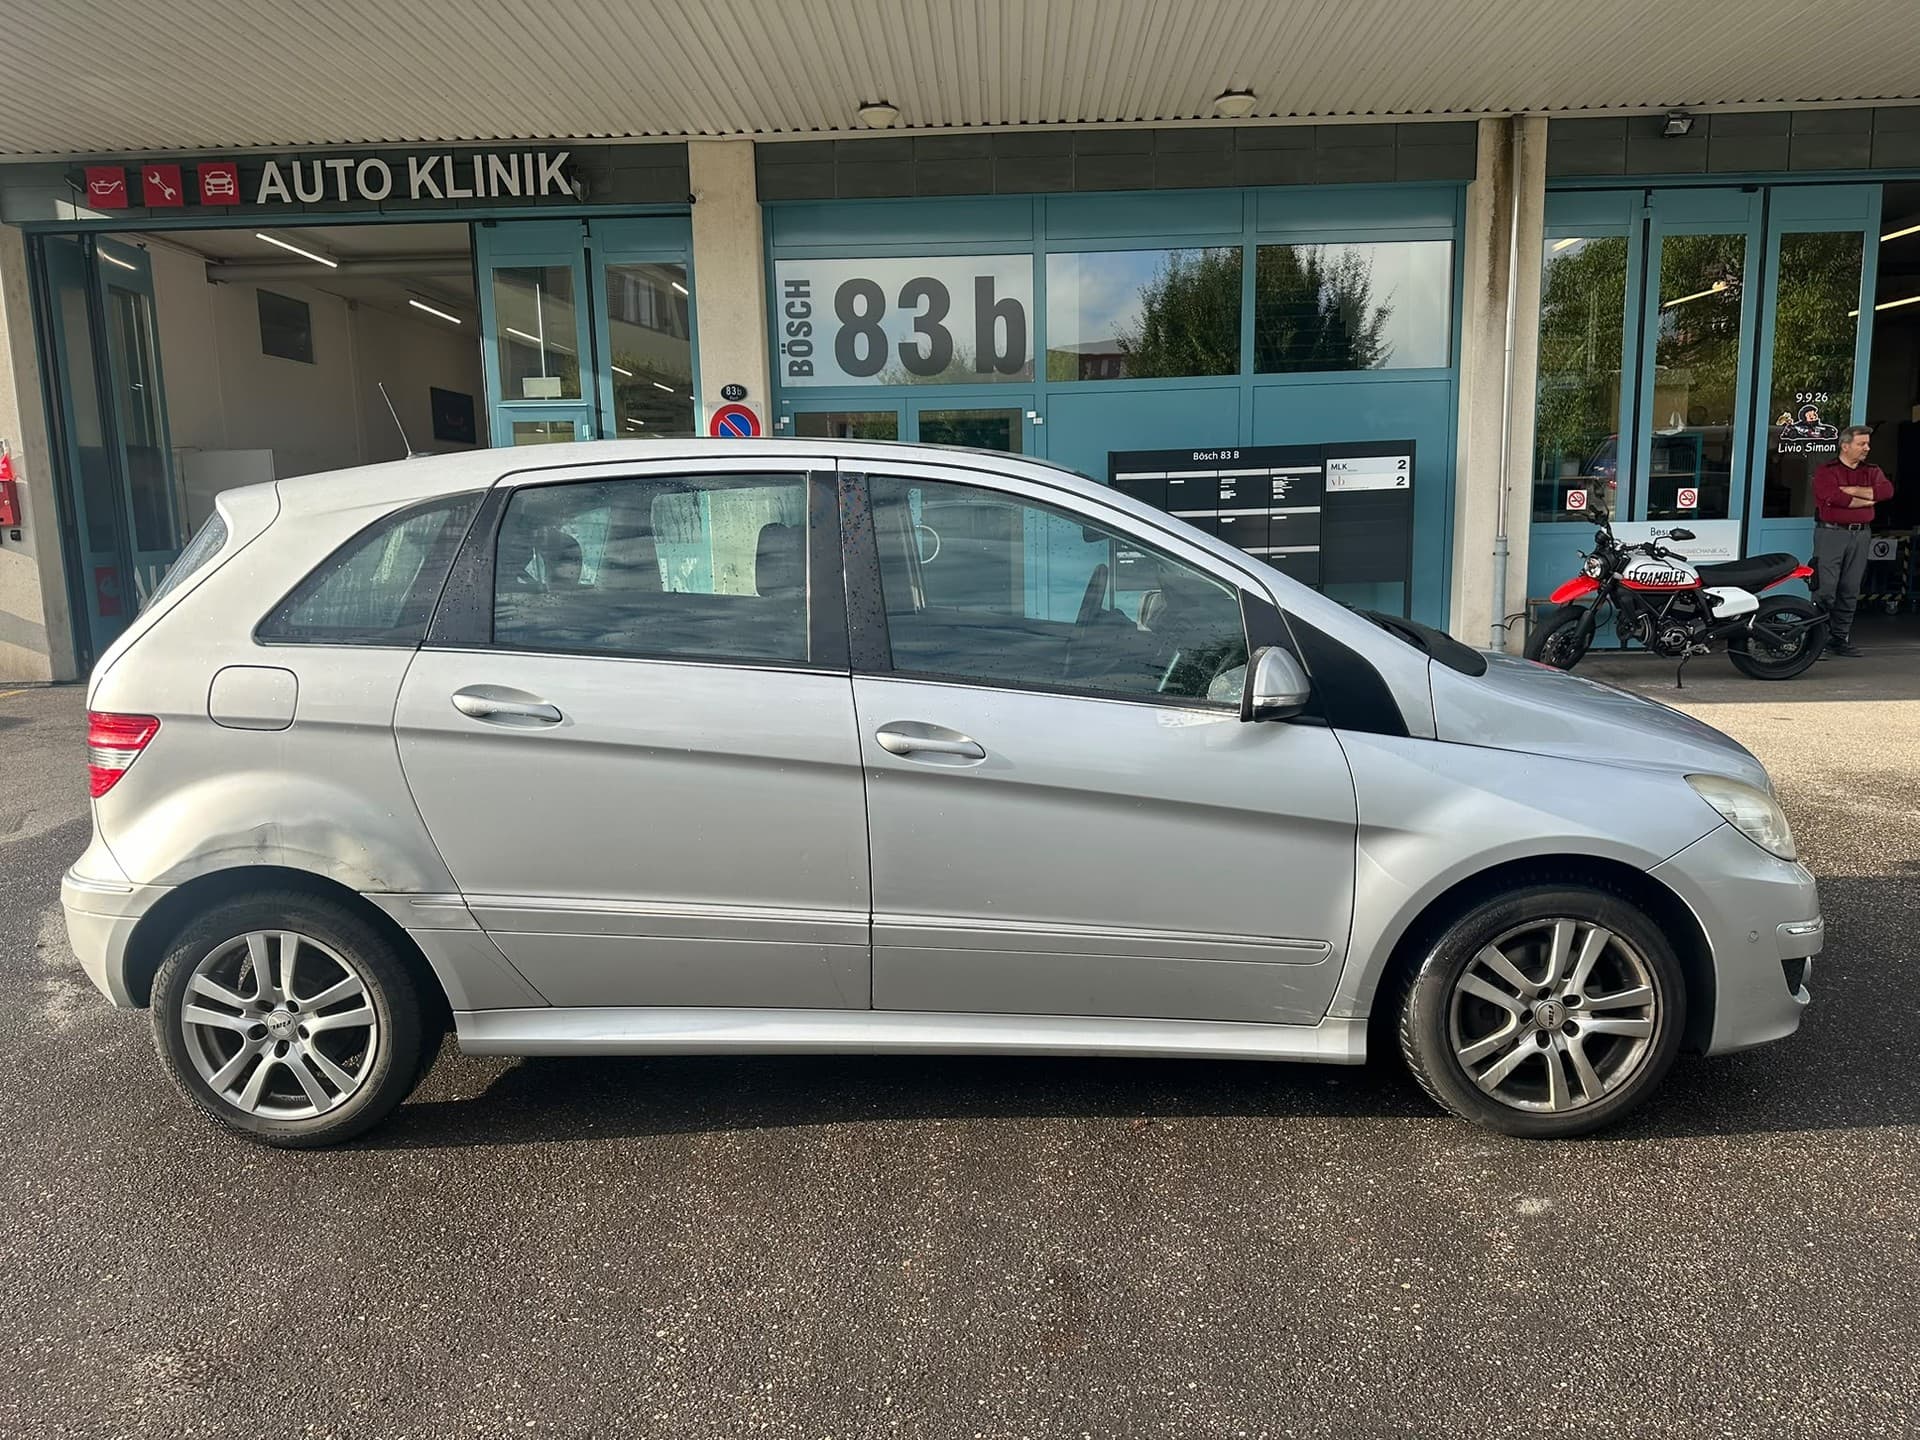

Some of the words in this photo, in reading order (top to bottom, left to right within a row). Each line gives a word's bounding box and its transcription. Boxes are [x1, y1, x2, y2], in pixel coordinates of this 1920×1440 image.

[256, 158, 392, 204] AUTO
[407, 151, 574, 200] KLINIK
[781, 279, 814, 377] BÖSCH
[1795, 392, 1829, 403] 9.9.26
[1778, 442, 1802, 453] Livio
[1805, 442, 1836, 452] Simon
[1220, 450, 1232, 460] 83
[1233, 450, 1240, 459] B
[1330, 463, 1348, 471] MLK
[1397, 459, 1407, 470] 2
[1396, 475, 1405, 486] 2
[1628, 569, 1686, 584] SCRAMBLER
